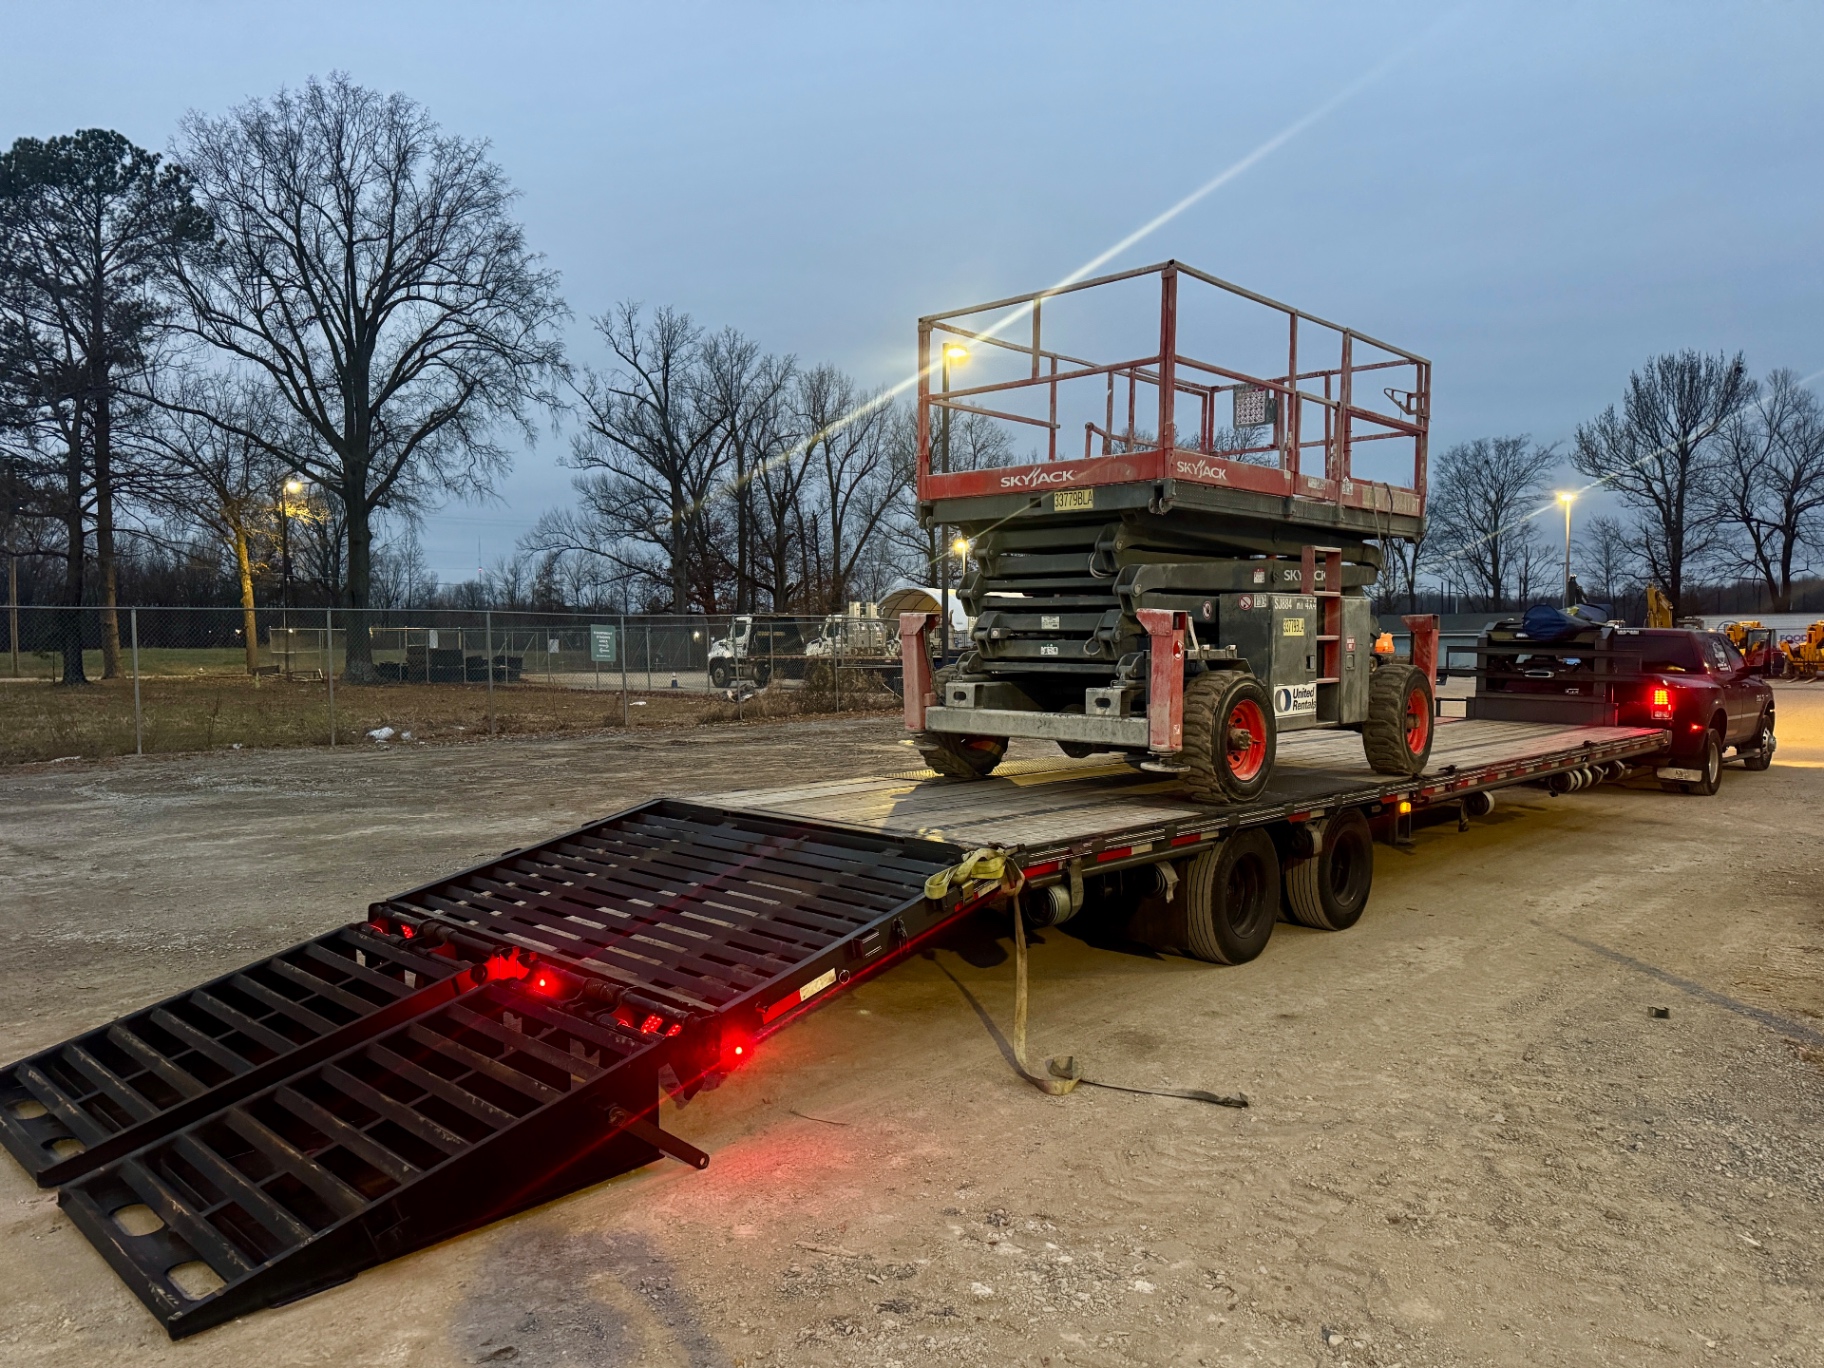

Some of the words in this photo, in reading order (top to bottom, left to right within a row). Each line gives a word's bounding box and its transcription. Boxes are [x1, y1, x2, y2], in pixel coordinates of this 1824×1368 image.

[1000, 467, 1075, 488] SKYJACK
[1177, 459, 1228, 480] SKYJACK
[1055, 491, 1093, 507] 33779BLA
[1293, 686, 1315, 699] United
[1292, 698, 1317, 711] Rentals
